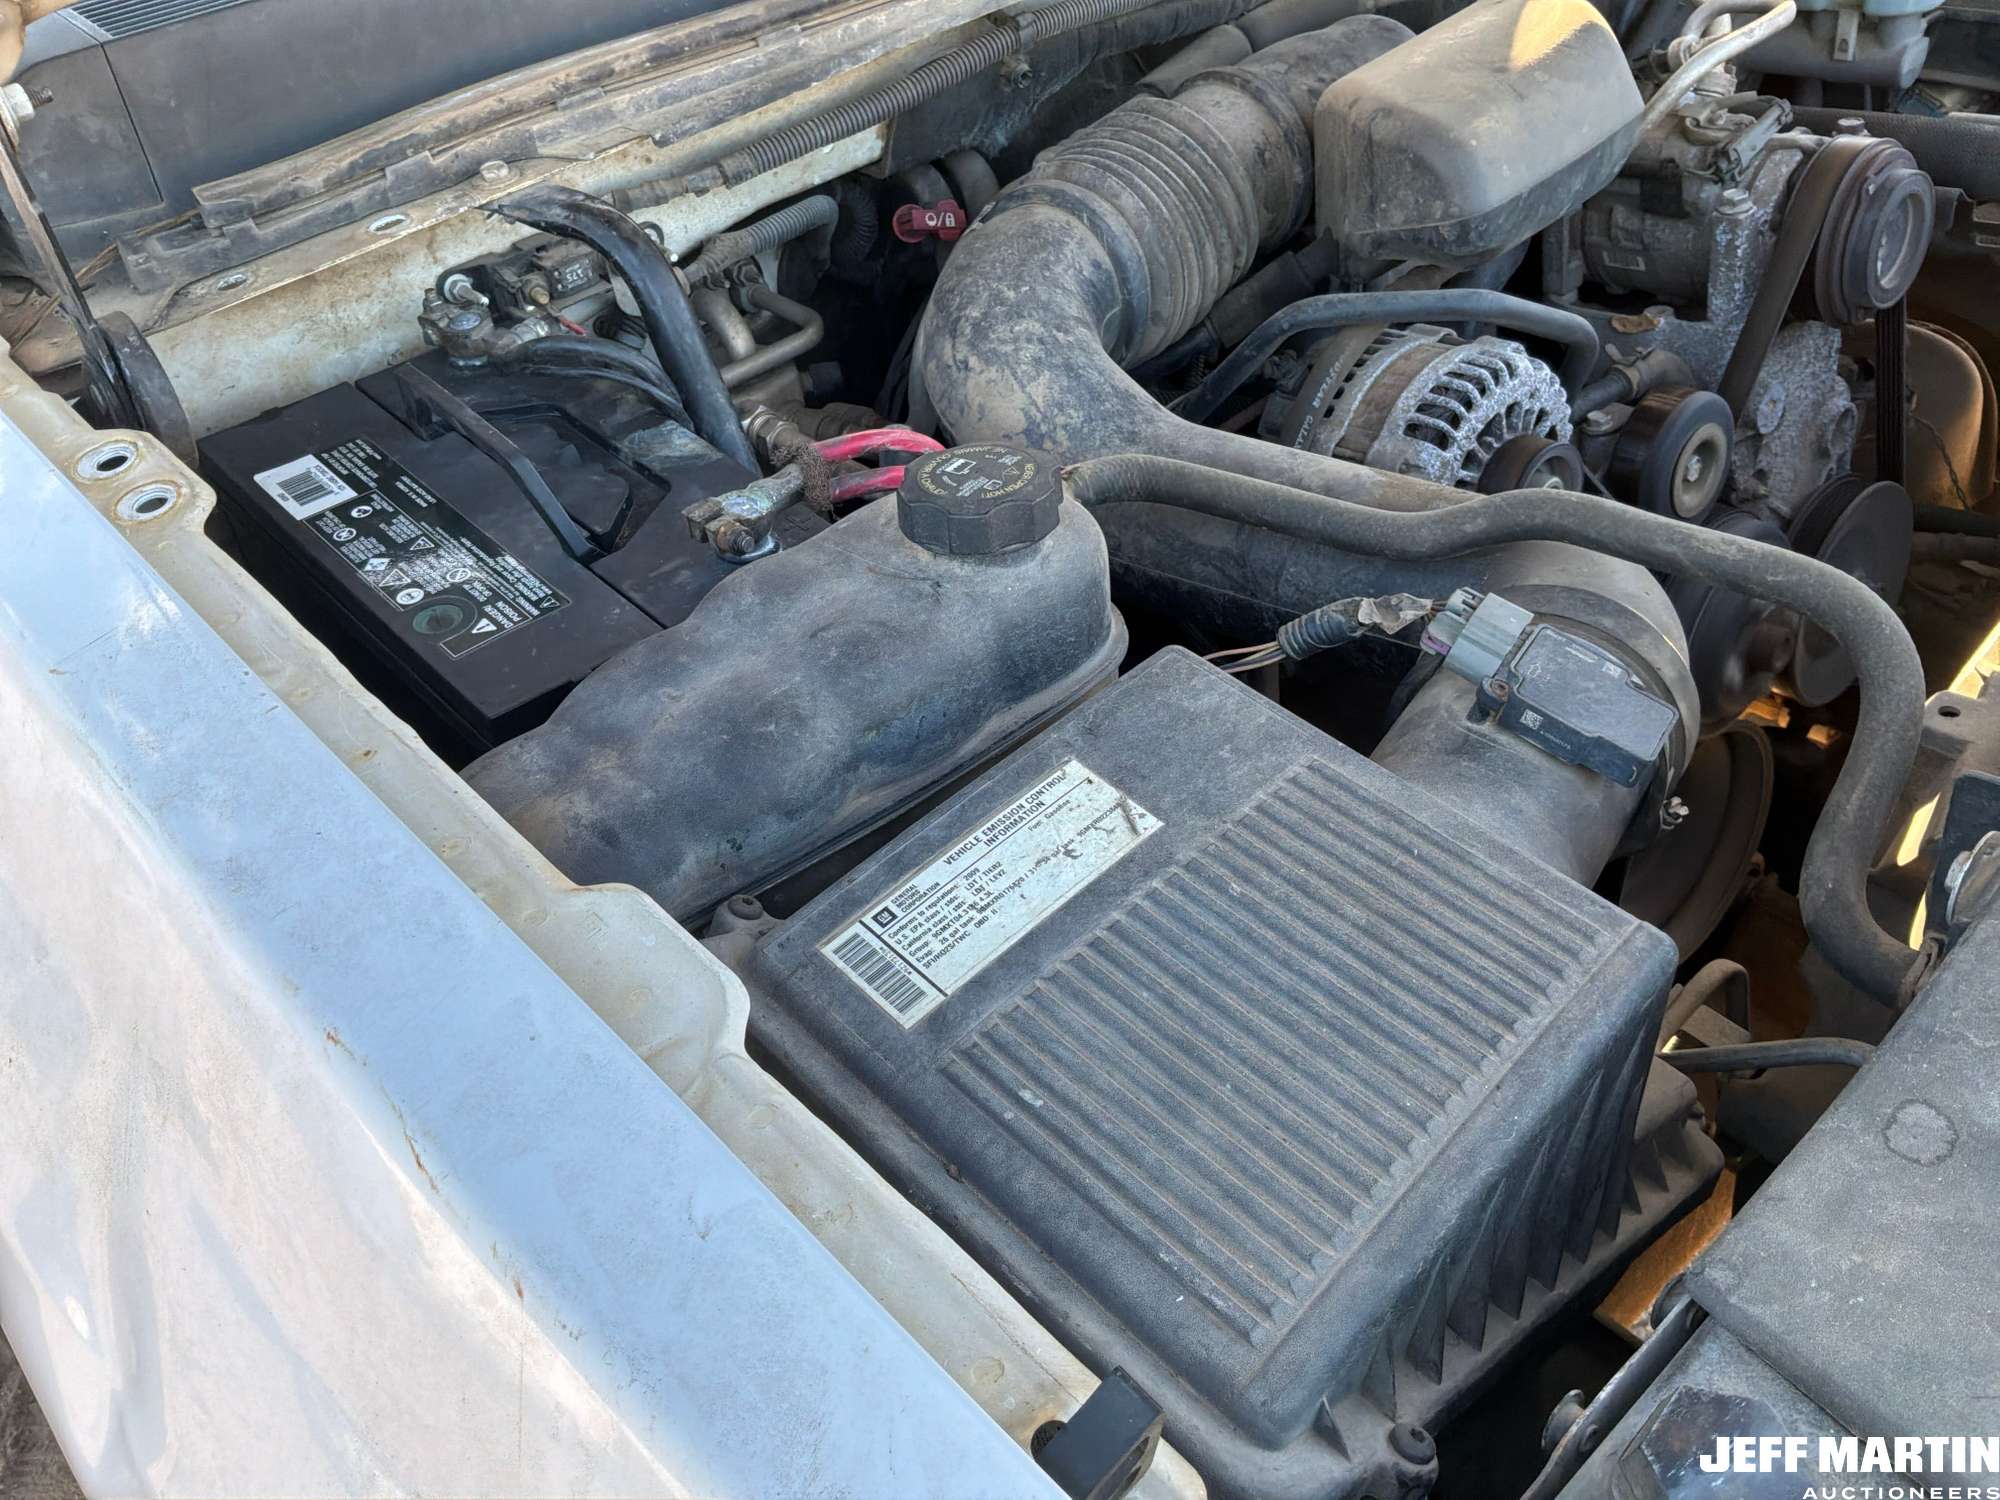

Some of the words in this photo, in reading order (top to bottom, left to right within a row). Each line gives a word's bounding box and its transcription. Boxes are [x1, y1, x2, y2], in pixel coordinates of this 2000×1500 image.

[493, 599, 523, 622] POISON
[942, 834, 984, 866] VEHICLE
[980, 802, 1027, 837] EMISSION
[1022, 772, 1067, 805] CONTROL
[981, 798, 1047, 848] INFORMATION
[1042, 797, 1072, 820] Gasoline
[886, 914, 919, 940] Conforms
[915, 908, 927, 917] to
[922, 881, 963, 912] regulations:
[961, 866, 982, 882] 2009
[889, 882, 919, 905] GENERAL
[894, 887, 922, 909] MOTORS
[898, 880, 942, 913] CORPORATION
[899, 925, 934, 952] California
[929, 913, 949, 929] class
[987, 867, 1008, 884] LEV2
[908, 920, 925, 934] EPA
[921, 907, 941, 923] class
[942, 892, 962, 908] stds:
[962, 878, 980, 892] LDT
[981, 860, 1004, 877] TIER2
[907, 937, 933, 958] Group:
[976, 888, 995, 903] 4.3L
[914, 947, 936, 964] Evap:
[937, 935, 950, 946] 26
[946, 926, 962, 939] gal
[957, 912, 978, 929] tank:
